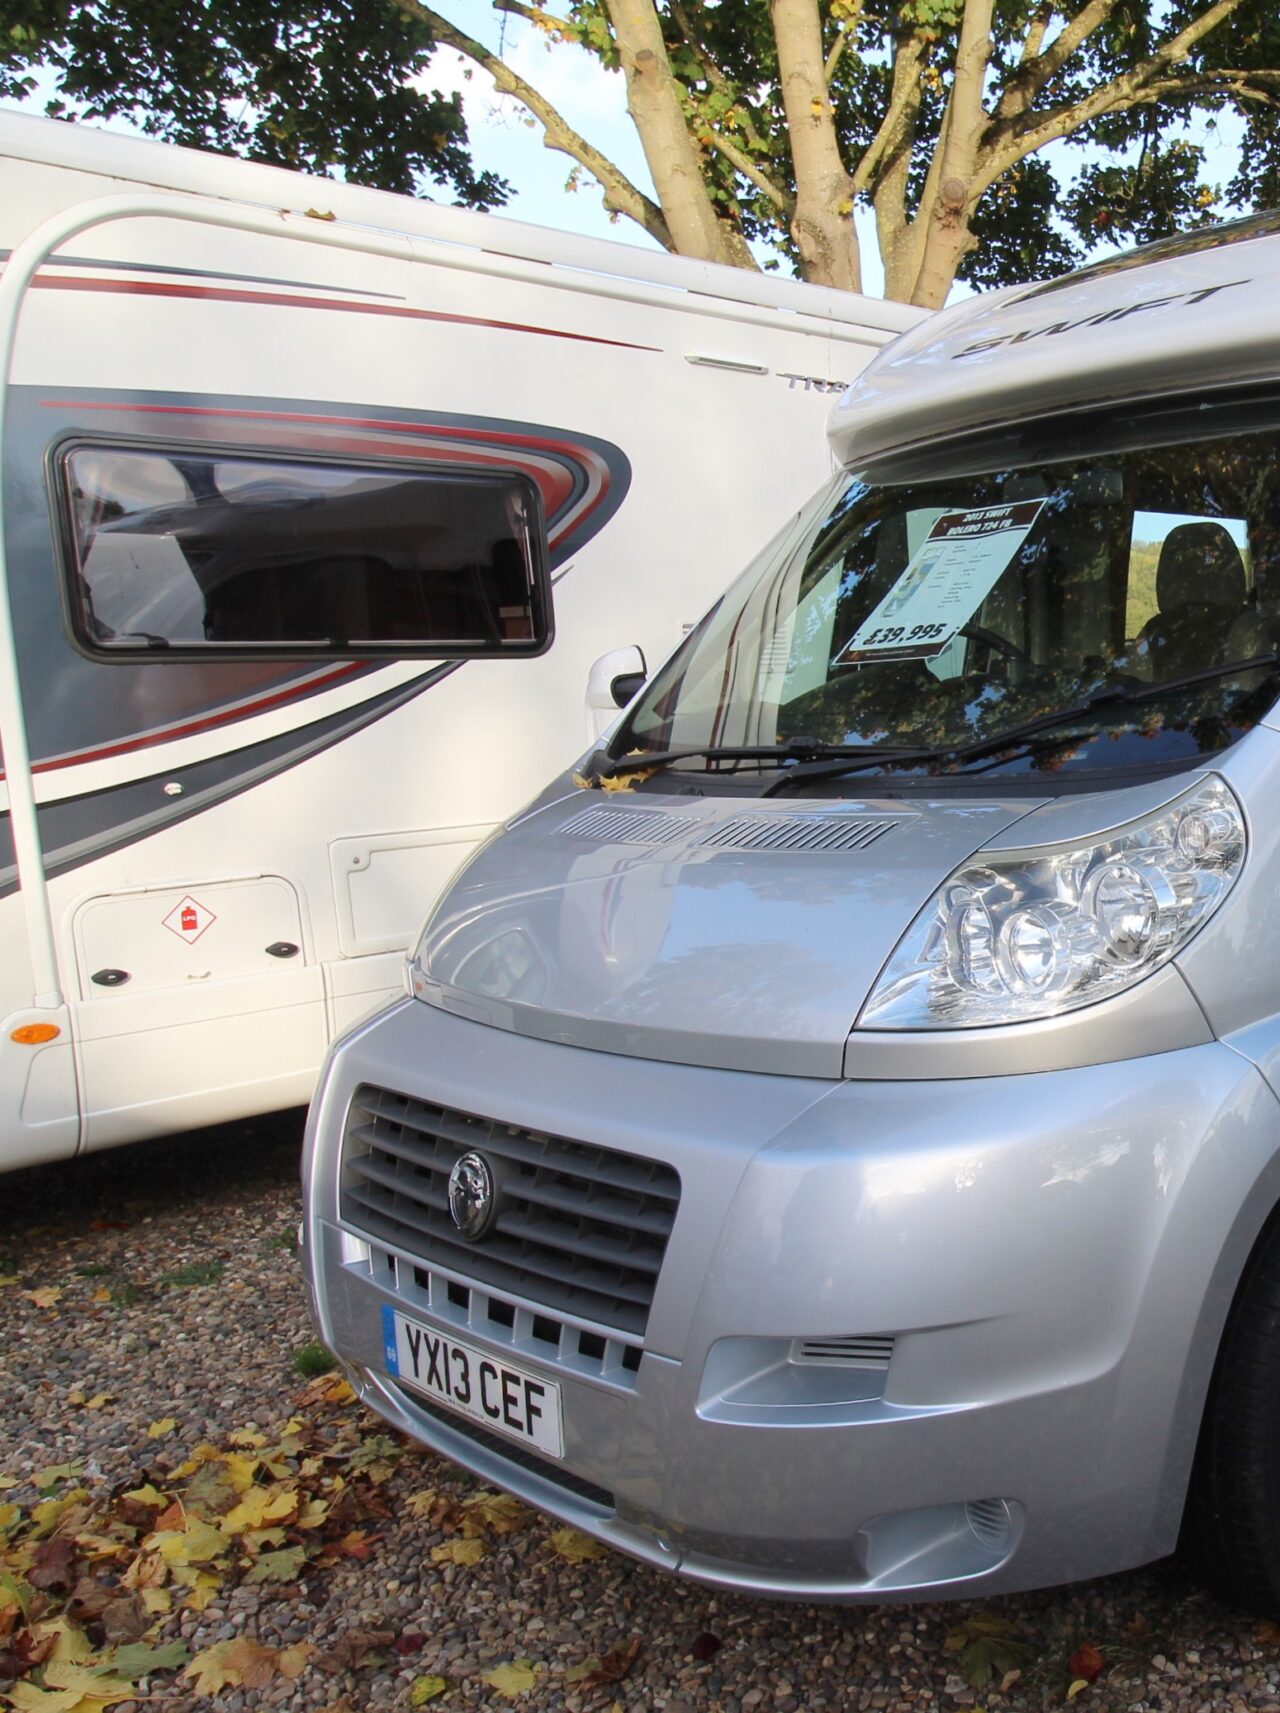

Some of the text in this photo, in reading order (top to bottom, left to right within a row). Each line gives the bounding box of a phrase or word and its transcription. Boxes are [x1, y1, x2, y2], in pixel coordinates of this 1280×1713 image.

[951, 278, 1253, 360] SWIFT
[962, 507, 1013, 523] 2013 SWIFT
[946, 522, 982, 536] BOLERO
[981, 520, 999, 532] 724
[862, 623, 948, 646] £39,995
[405, 1323, 545, 1437] YX13 CEF
